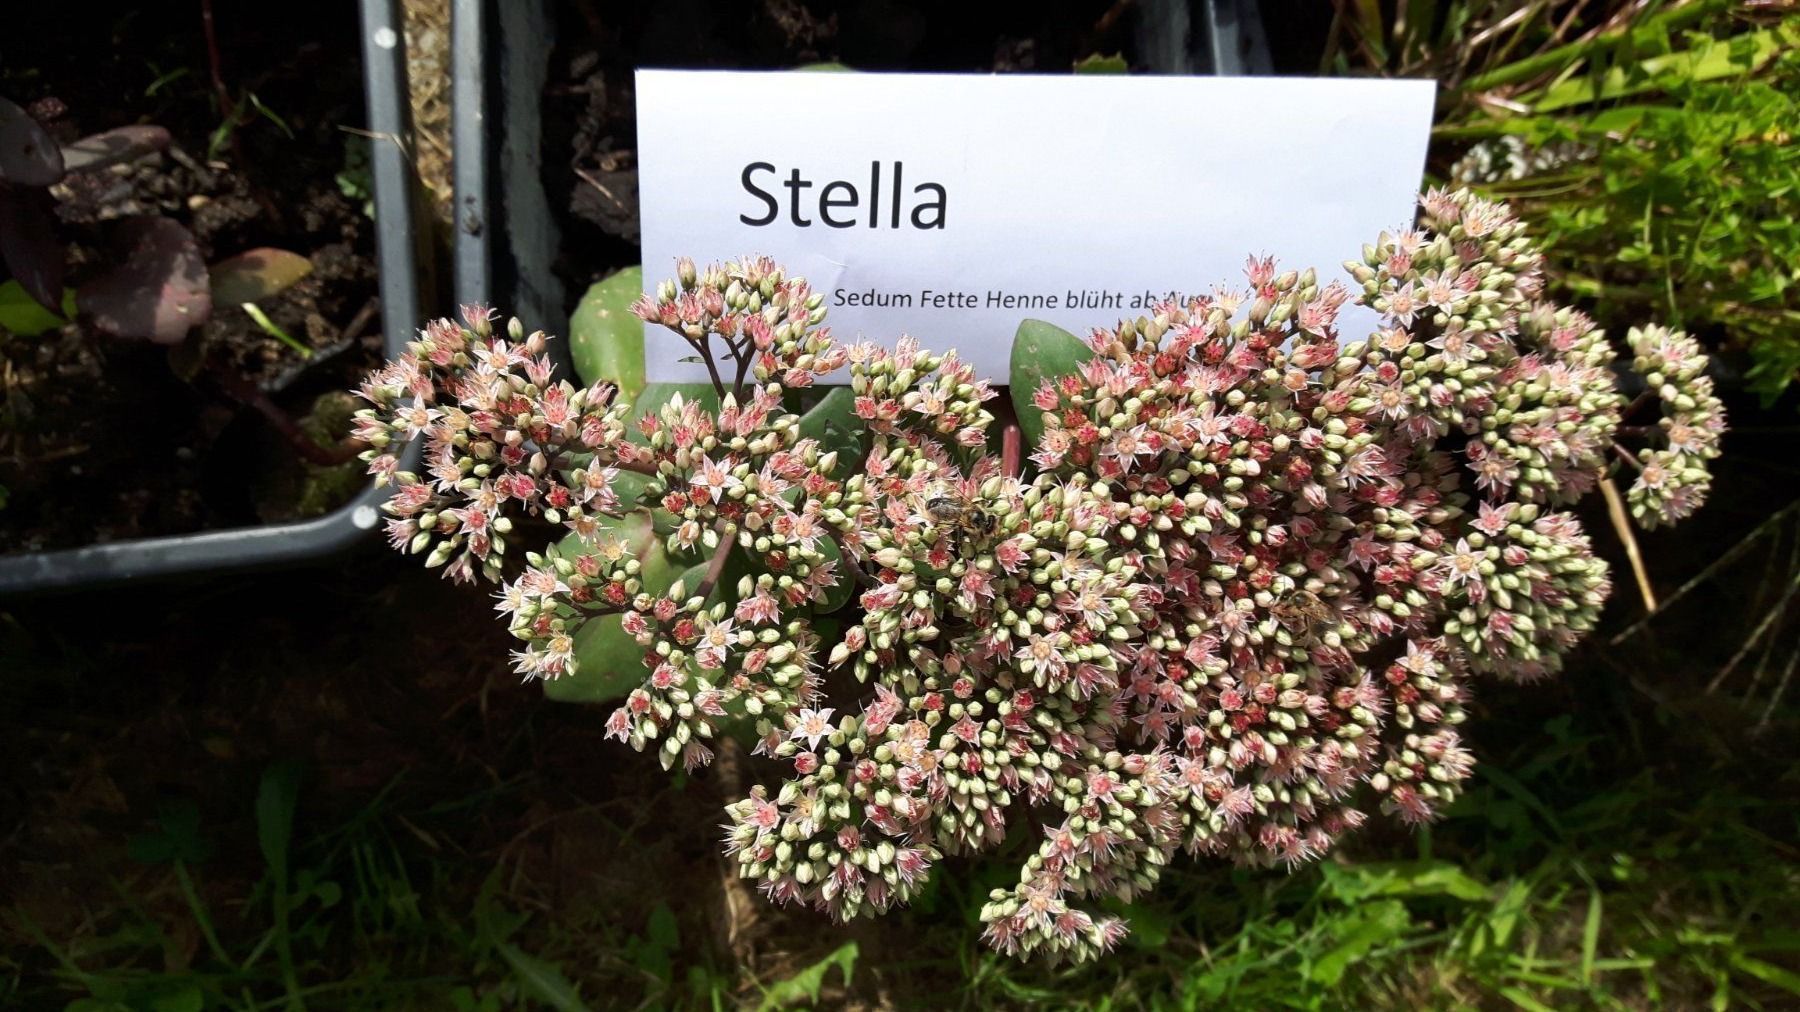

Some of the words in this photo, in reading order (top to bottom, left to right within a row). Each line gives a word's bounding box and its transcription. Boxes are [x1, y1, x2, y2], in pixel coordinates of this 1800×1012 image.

[740, 161, 947, 230] Stella
[834, 288, 911, 308] Sedum
[920, 290, 978, 309] Fette
[986, 290, 1058, 309] Henne
[1065, 289, 1124, 309] blüht
[1129, 290, 1157, 309] ab
